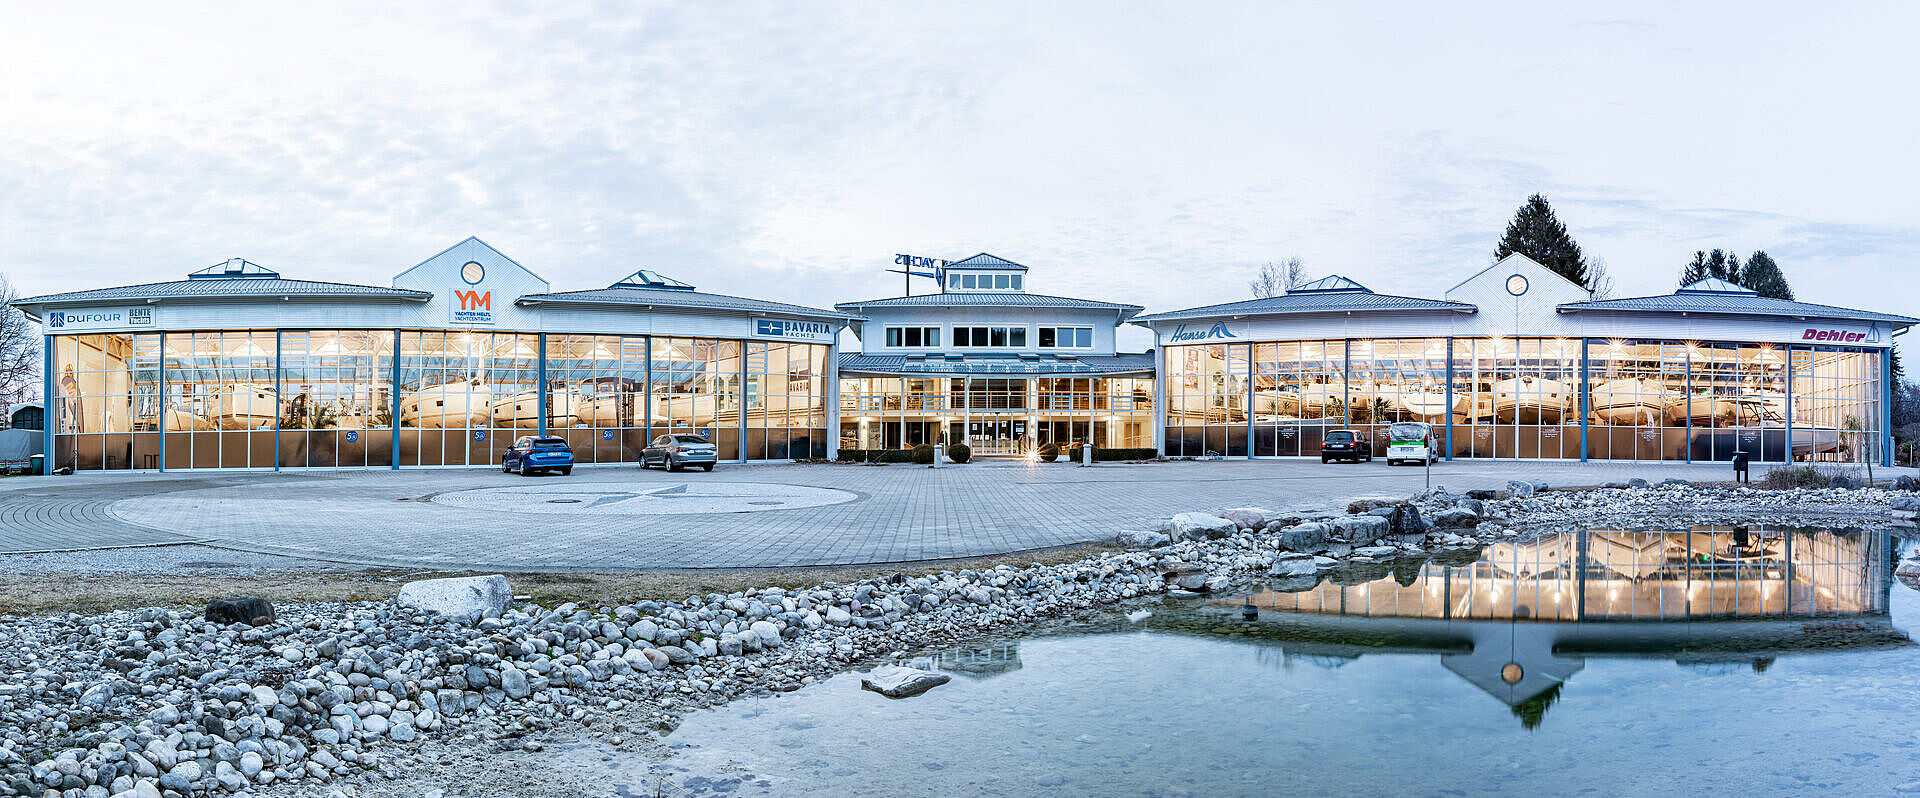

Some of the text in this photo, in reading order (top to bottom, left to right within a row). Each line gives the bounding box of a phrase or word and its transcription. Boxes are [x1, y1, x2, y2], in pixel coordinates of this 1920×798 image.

[455, 290, 490, 311] YM
[67, 313, 120, 323] DUFOUR
[129, 308, 151, 317] BENTE
[784, 322, 830, 334] BAVARIA
[1170, 323, 1206, 342] Hanse
[1802, 328, 1866, 342] Dehler
